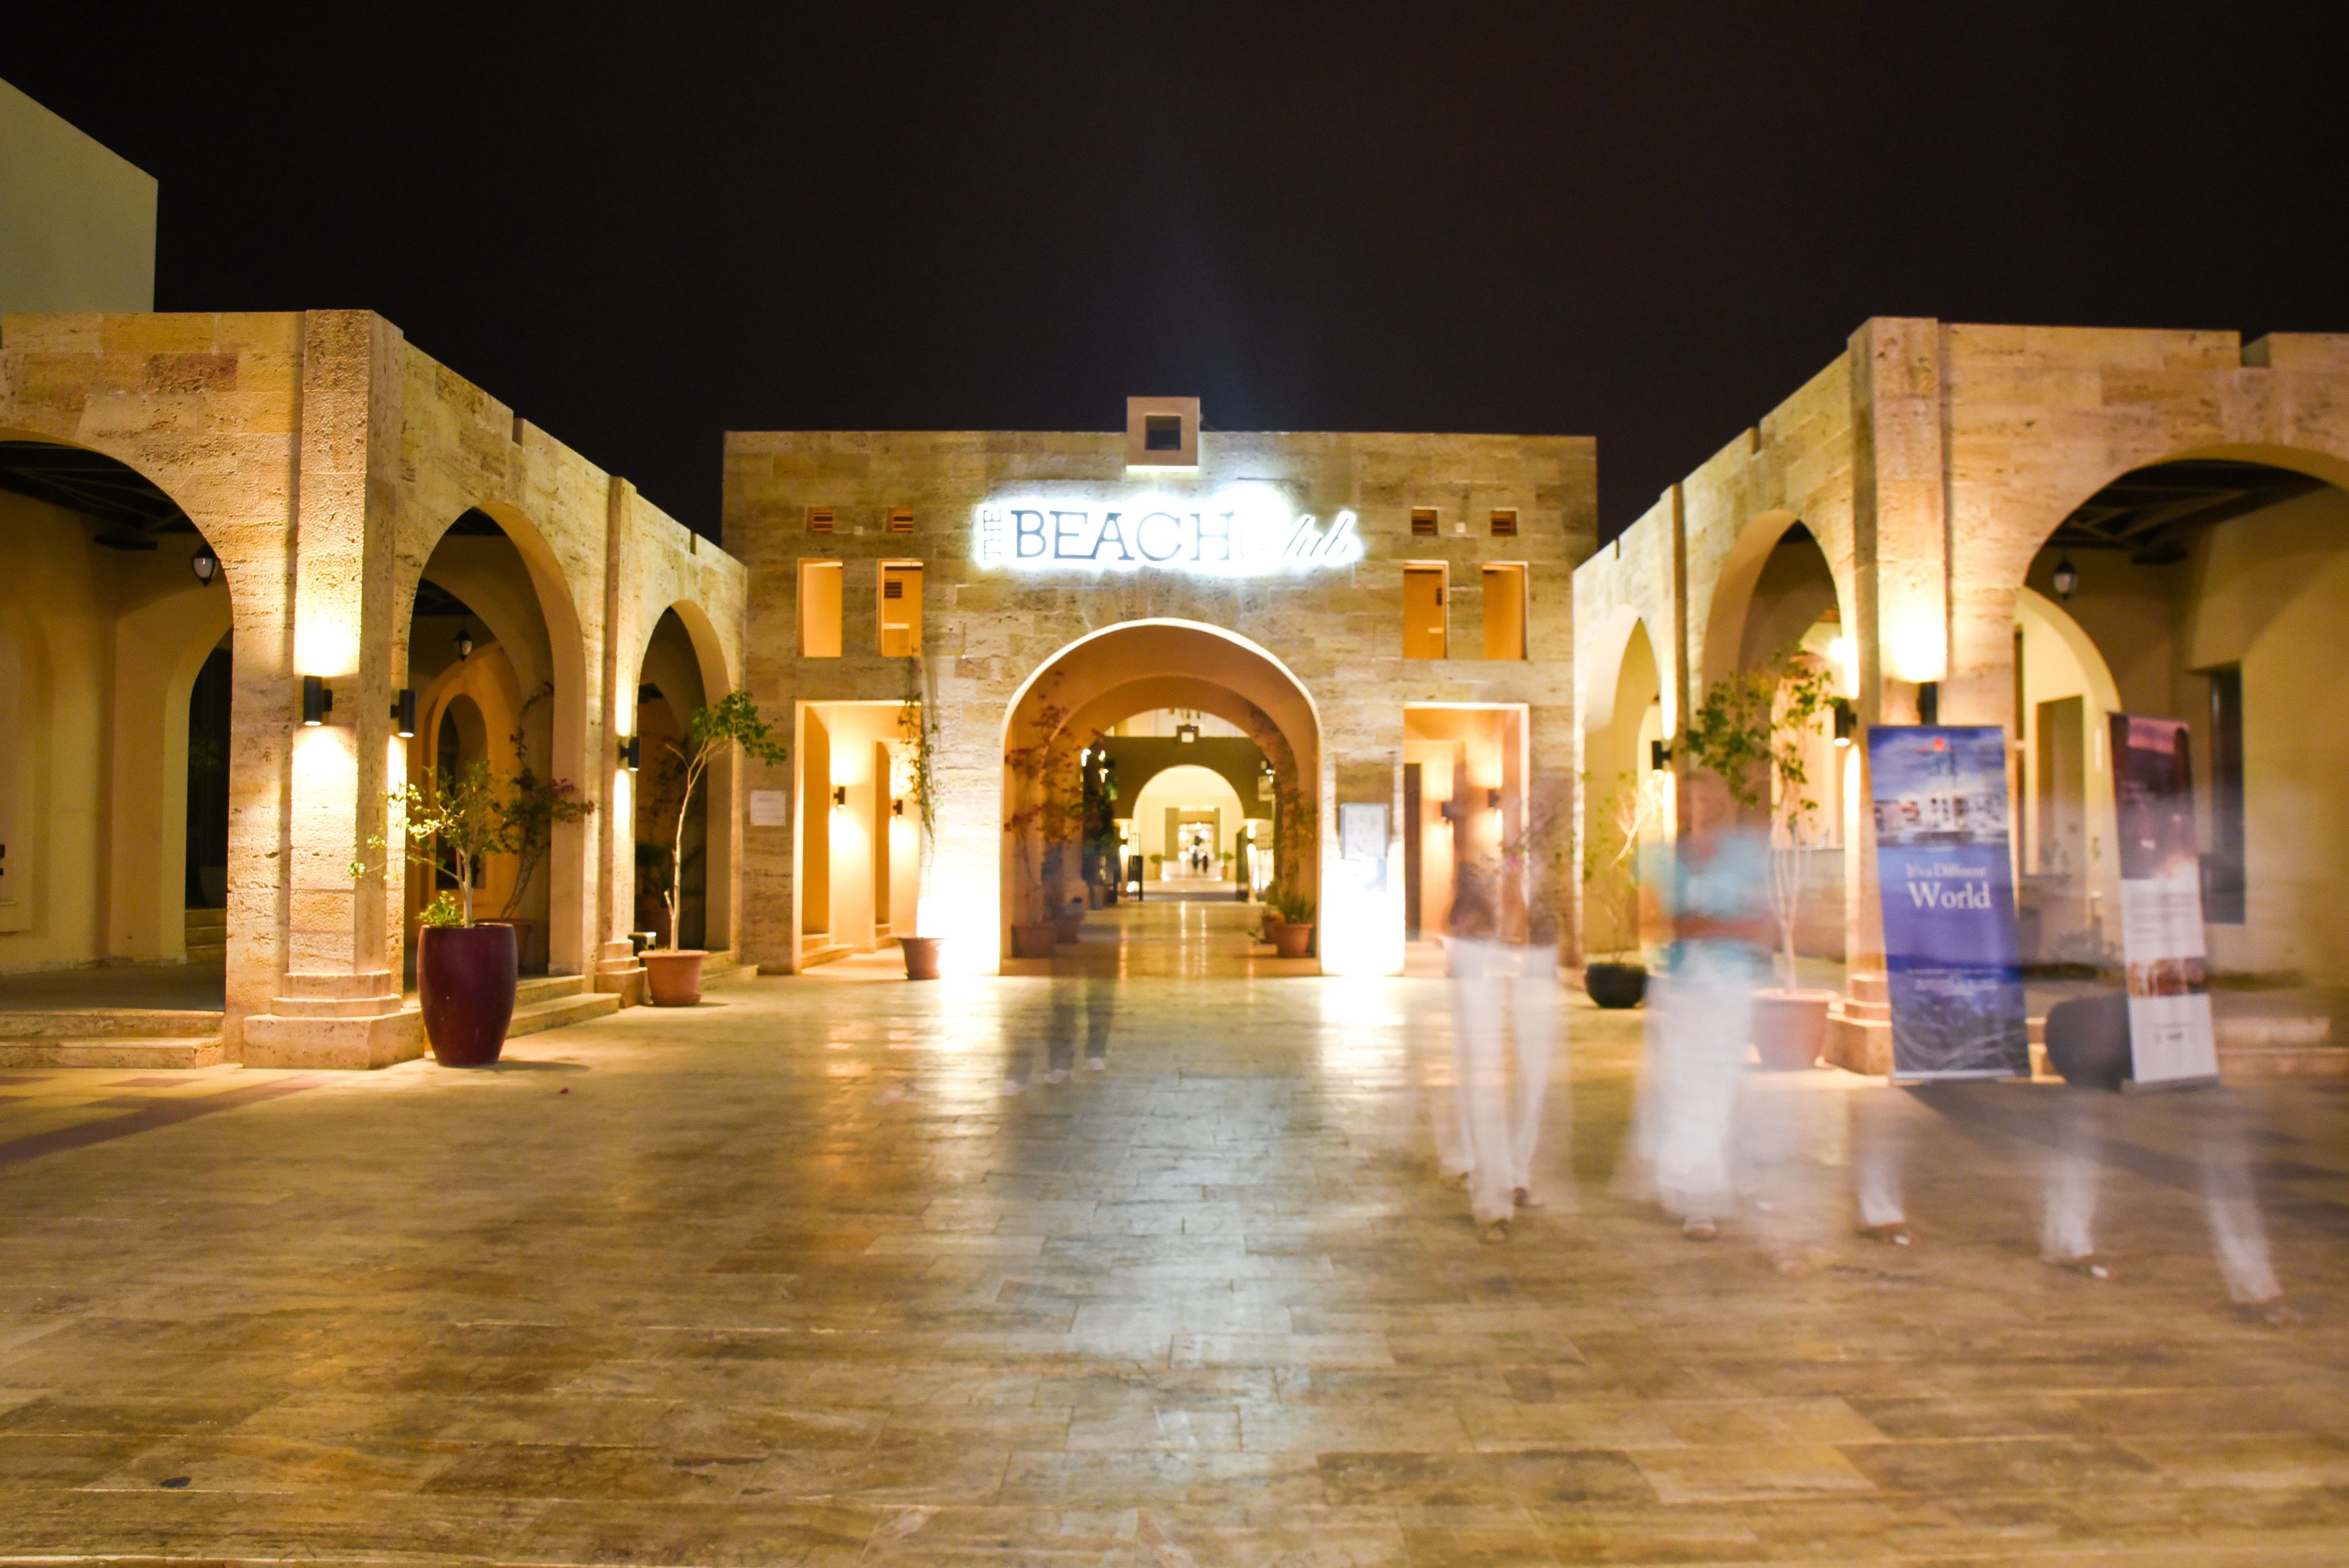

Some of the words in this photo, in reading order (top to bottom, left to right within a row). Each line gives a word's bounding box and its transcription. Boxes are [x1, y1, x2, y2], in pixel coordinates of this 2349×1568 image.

[983, 508, 1001, 560] THE
[1010, 509, 1235, 562] BEACH
[1907, 881, 1992, 909] World
